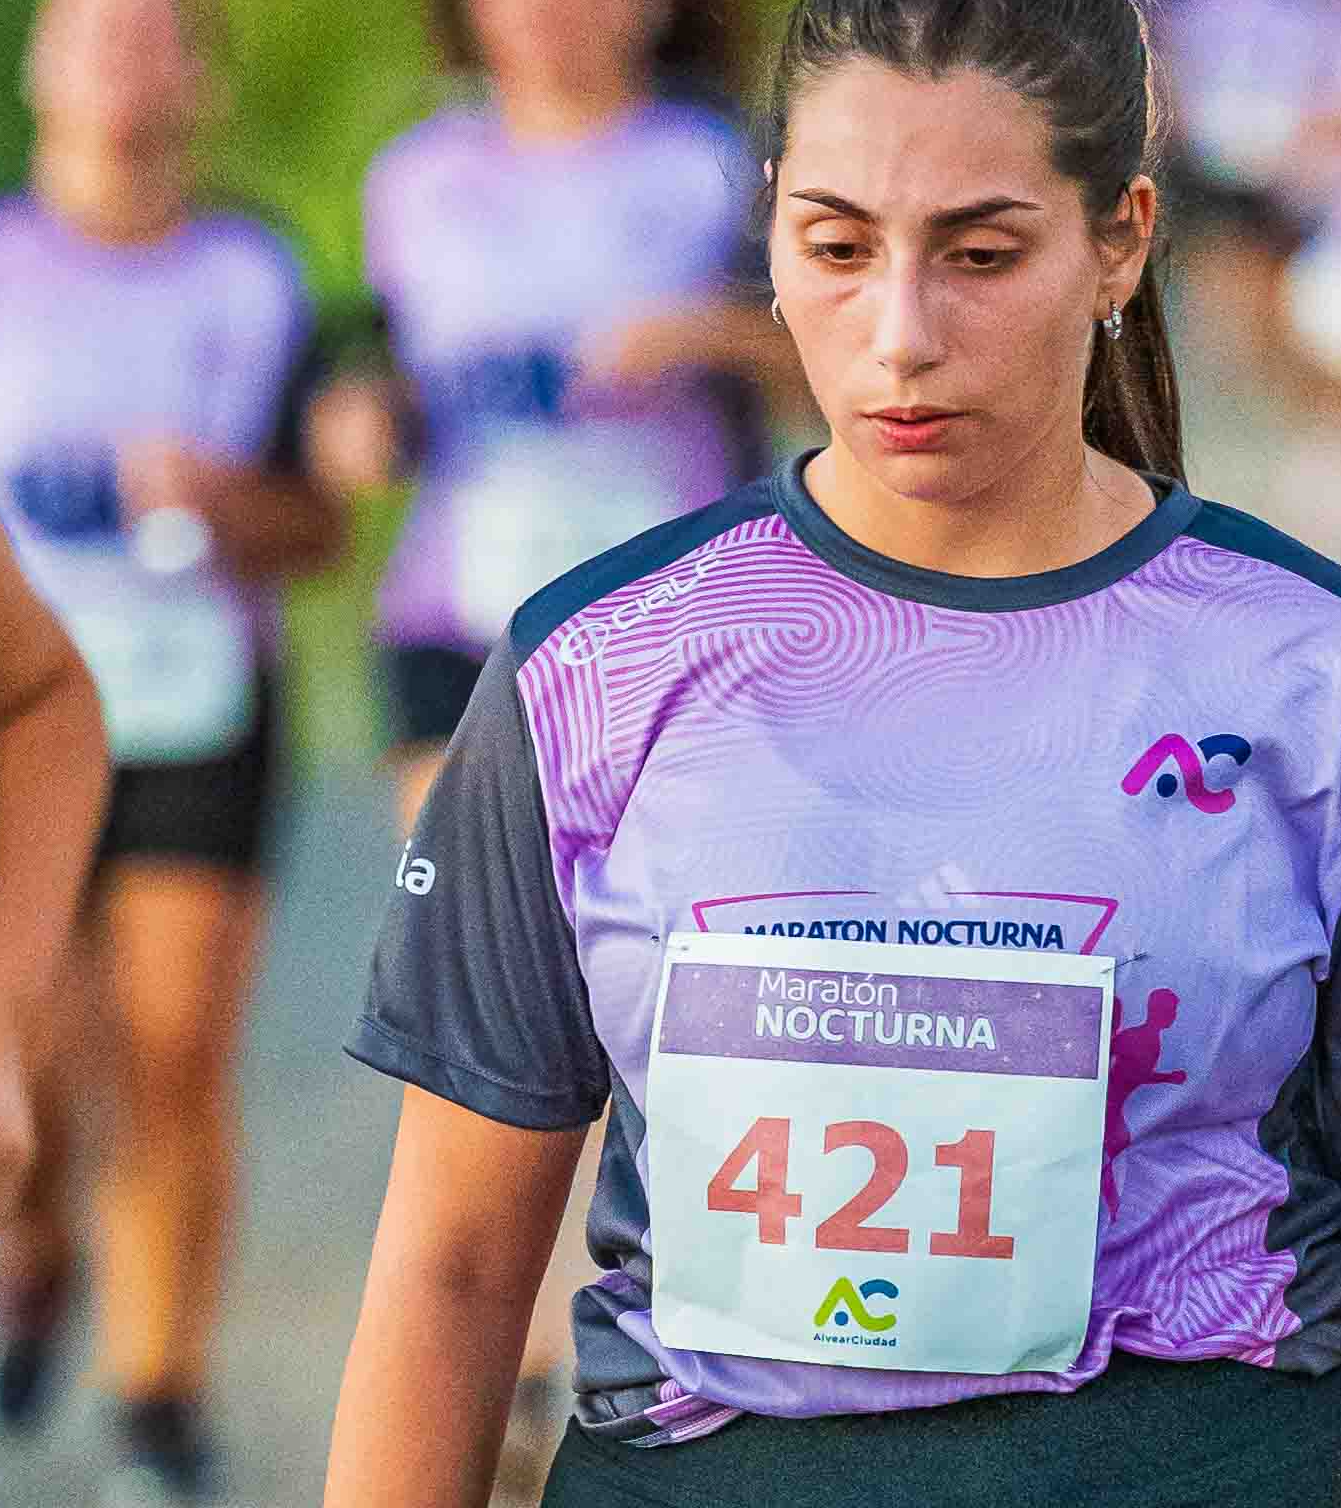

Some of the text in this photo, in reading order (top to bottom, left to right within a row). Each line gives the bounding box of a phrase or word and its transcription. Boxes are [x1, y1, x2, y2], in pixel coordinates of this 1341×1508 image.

[897, 920, 1066, 950] NOCTURNA
[758, 969, 898, 1007] Maratón
[755, 1004, 997, 1051] NOCTURNA
[707, 1116, 1015, 1260] 421
